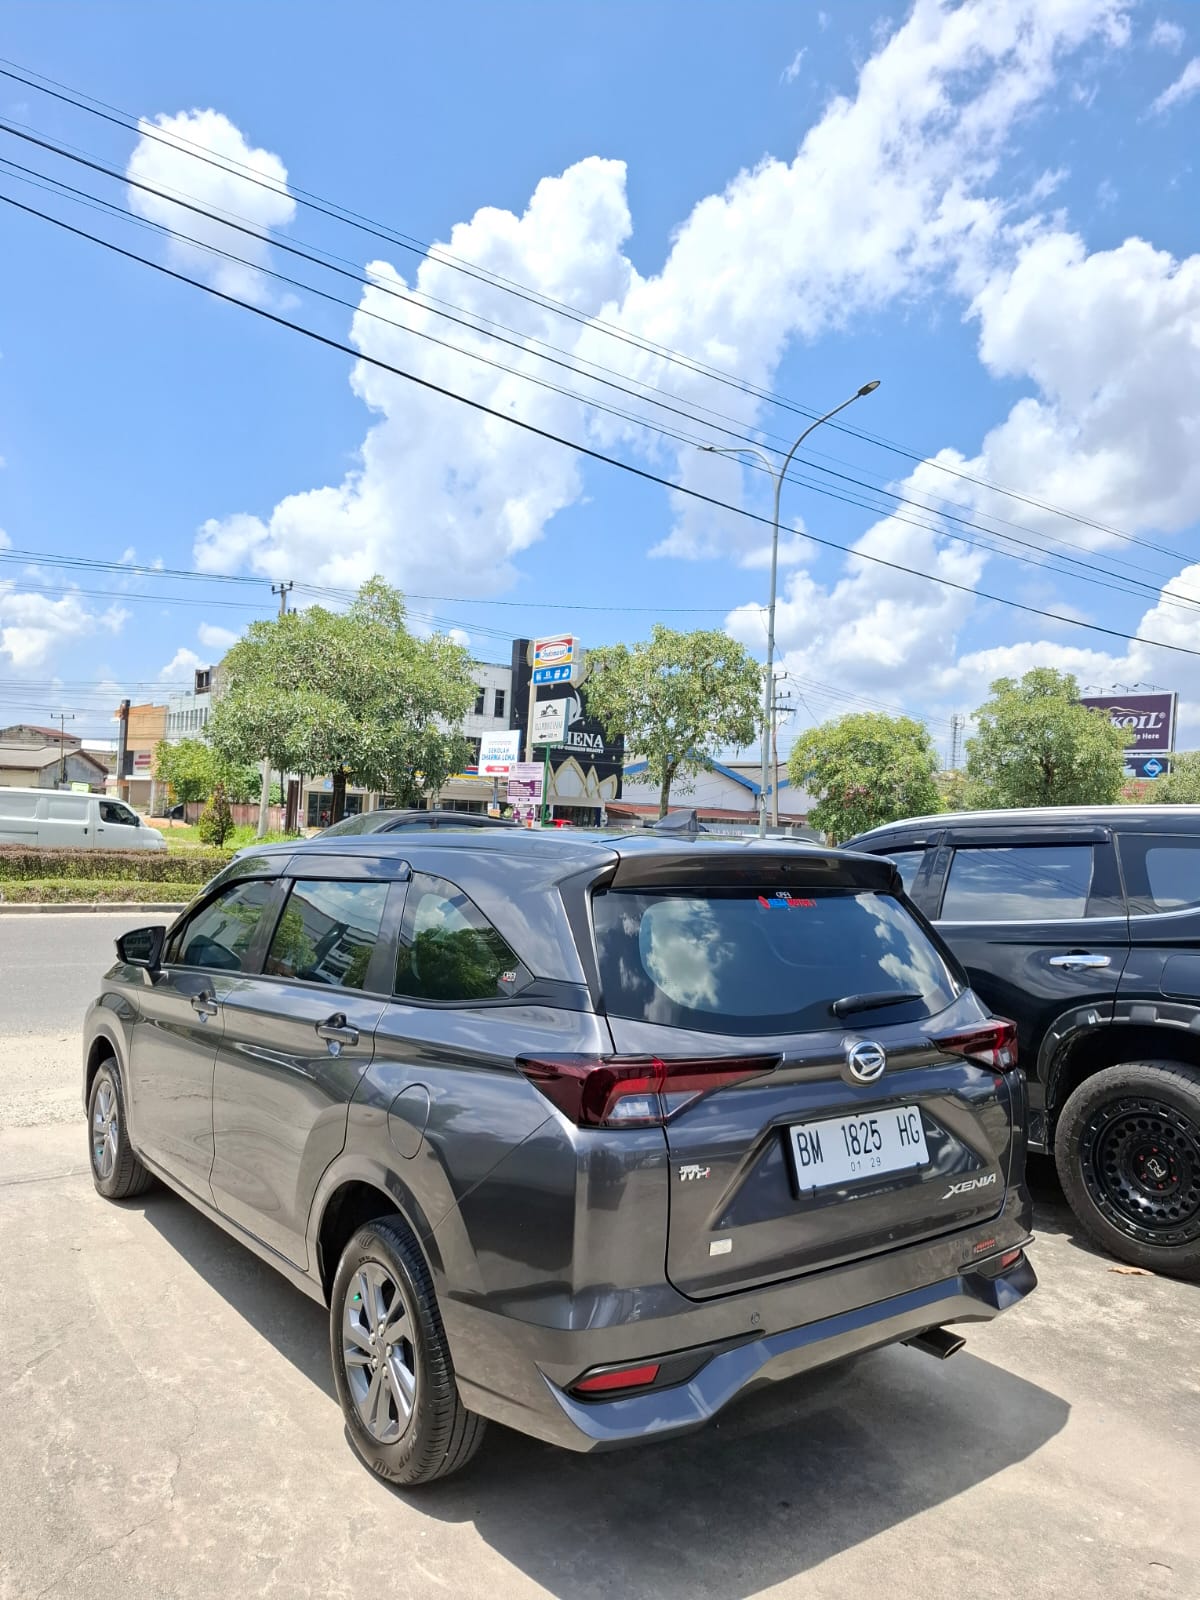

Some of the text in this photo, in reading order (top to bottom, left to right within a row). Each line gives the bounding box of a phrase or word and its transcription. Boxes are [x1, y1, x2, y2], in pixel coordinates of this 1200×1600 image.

[797, 1113, 920, 1167] BM 1825 HG
[850, 1156, 882, 1172] 01 29
[942, 1173, 996, 1200] XENIA
